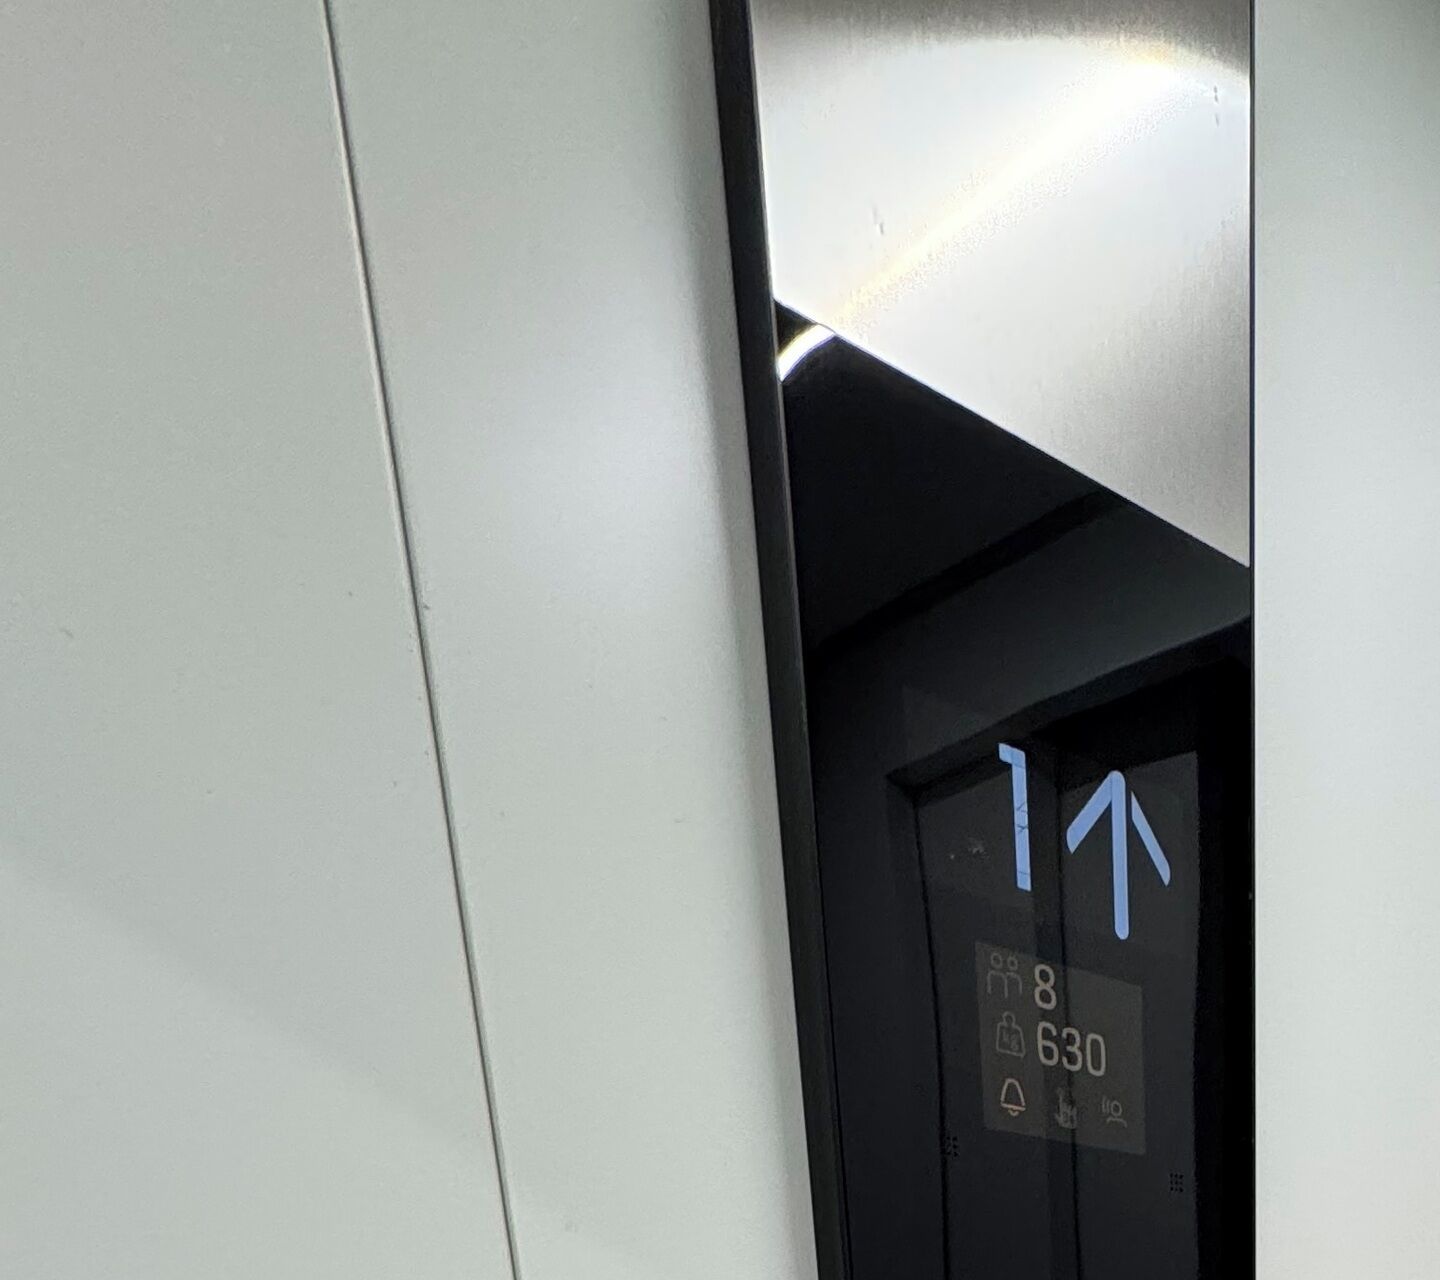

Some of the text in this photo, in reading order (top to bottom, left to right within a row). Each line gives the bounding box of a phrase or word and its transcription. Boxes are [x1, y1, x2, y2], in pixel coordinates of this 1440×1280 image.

[998, 742, 1032, 892] 1
[1034, 963, 1057, 1010] 8
[1036, 1020, 1107, 1077] 630
